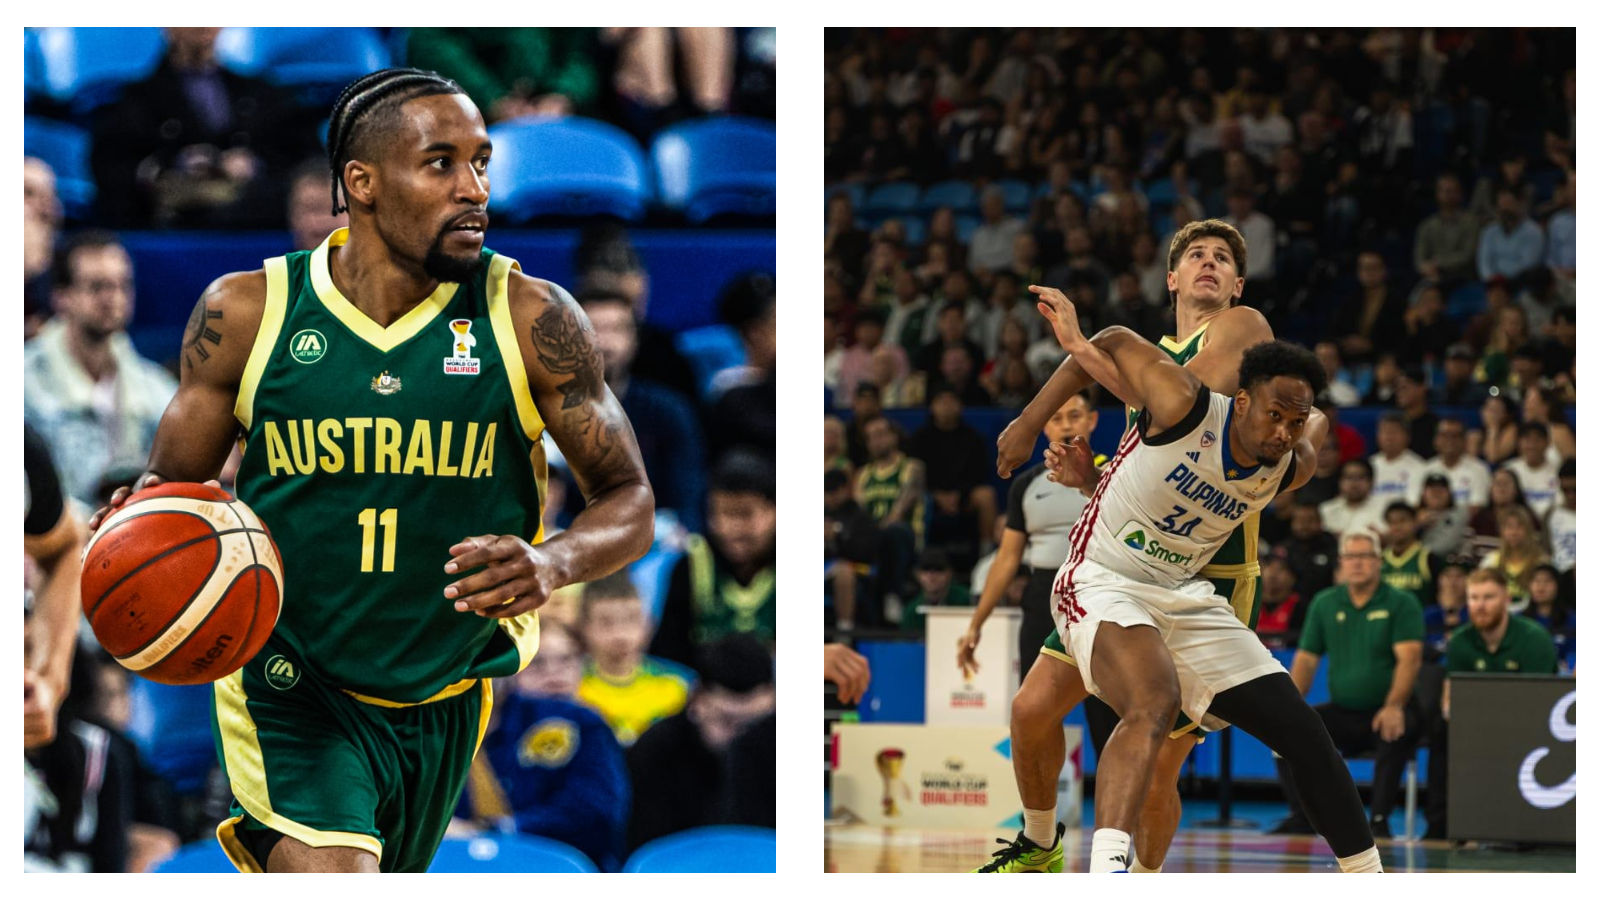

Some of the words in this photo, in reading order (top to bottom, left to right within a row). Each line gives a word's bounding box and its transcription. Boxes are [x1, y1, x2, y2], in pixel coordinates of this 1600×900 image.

[264, 417, 497, 478] AUSTRALIA
[1153, 505, 1203, 537] 34
[1165, 463, 1248, 521] PILIPINAS
[358, 508, 398, 572] 11
[1145, 540, 1194, 566] Smart
